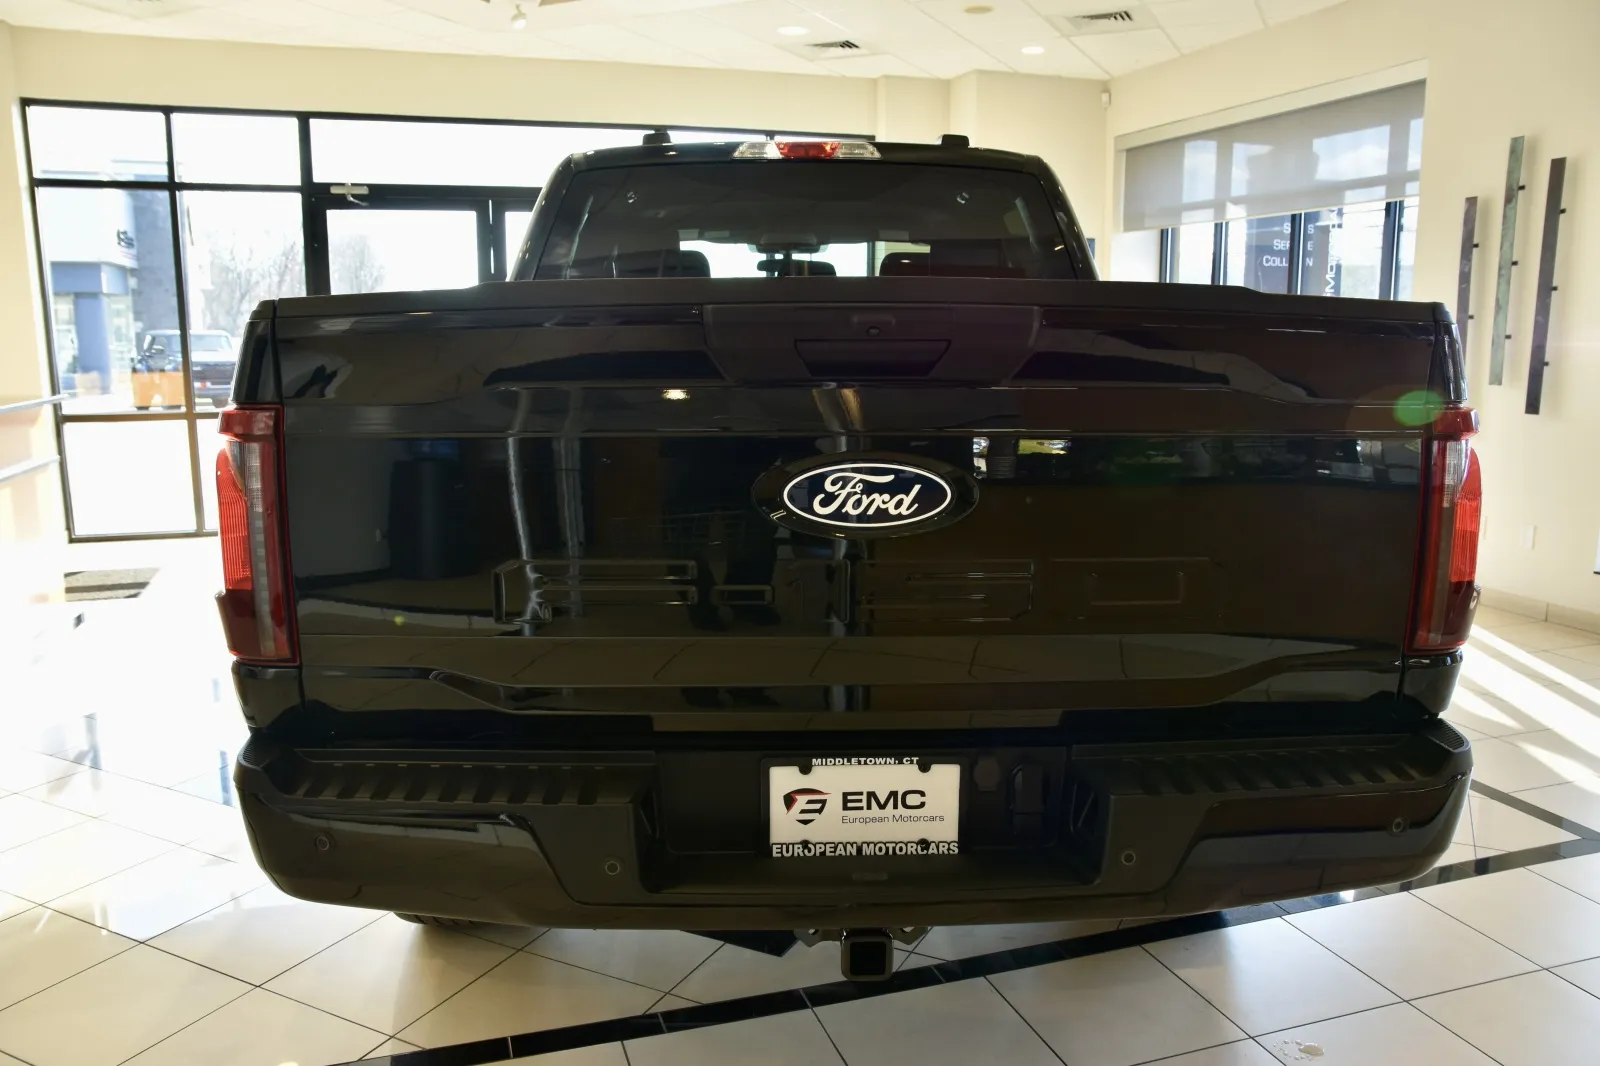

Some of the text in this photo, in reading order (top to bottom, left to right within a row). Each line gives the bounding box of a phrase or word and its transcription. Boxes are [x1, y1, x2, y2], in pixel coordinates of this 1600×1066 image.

[1262, 255, 1313, 267] COLLN
[812, 472, 922, 516] Ford
[811, 756, 919, 766] MIDDLETOWN, CT
[841, 789, 926, 811] EMC
[841, 814, 945, 824] European Motorcars
[772, 841, 959, 857] EUROPEAN MOTORCARS
